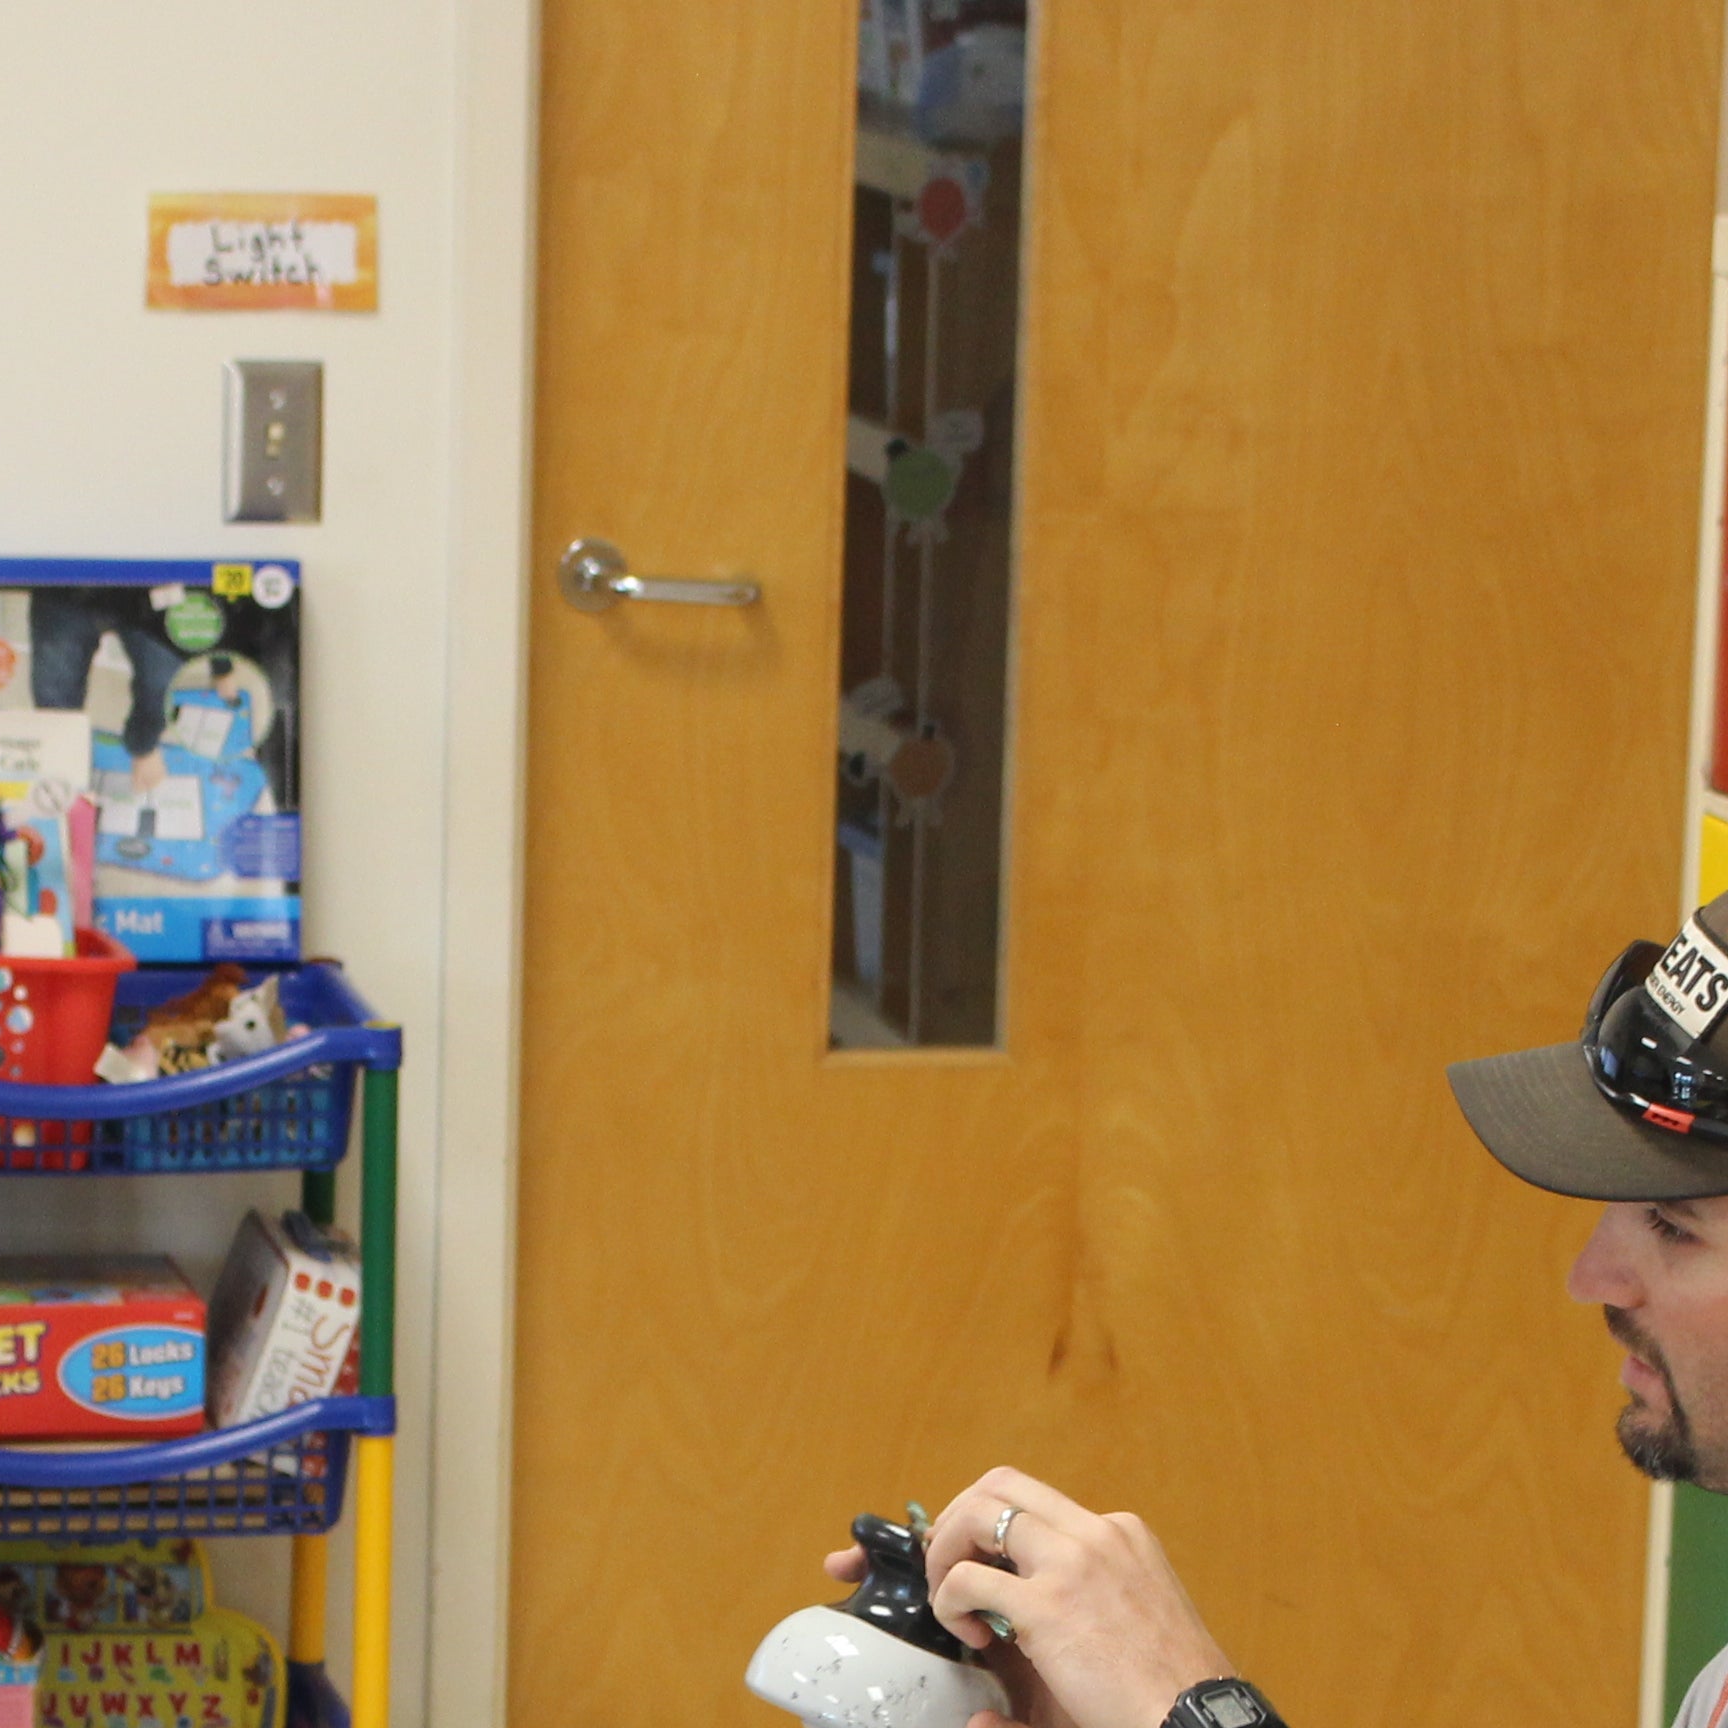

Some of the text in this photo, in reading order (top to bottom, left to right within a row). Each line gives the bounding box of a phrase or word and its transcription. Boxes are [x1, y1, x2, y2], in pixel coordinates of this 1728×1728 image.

[210, 220, 303, 263] Light
[204, 251, 318, 286] Switch
[91, 1338, 194, 1371] 26 Locks
[91, 1373, 185, 1404] 26 Keys
